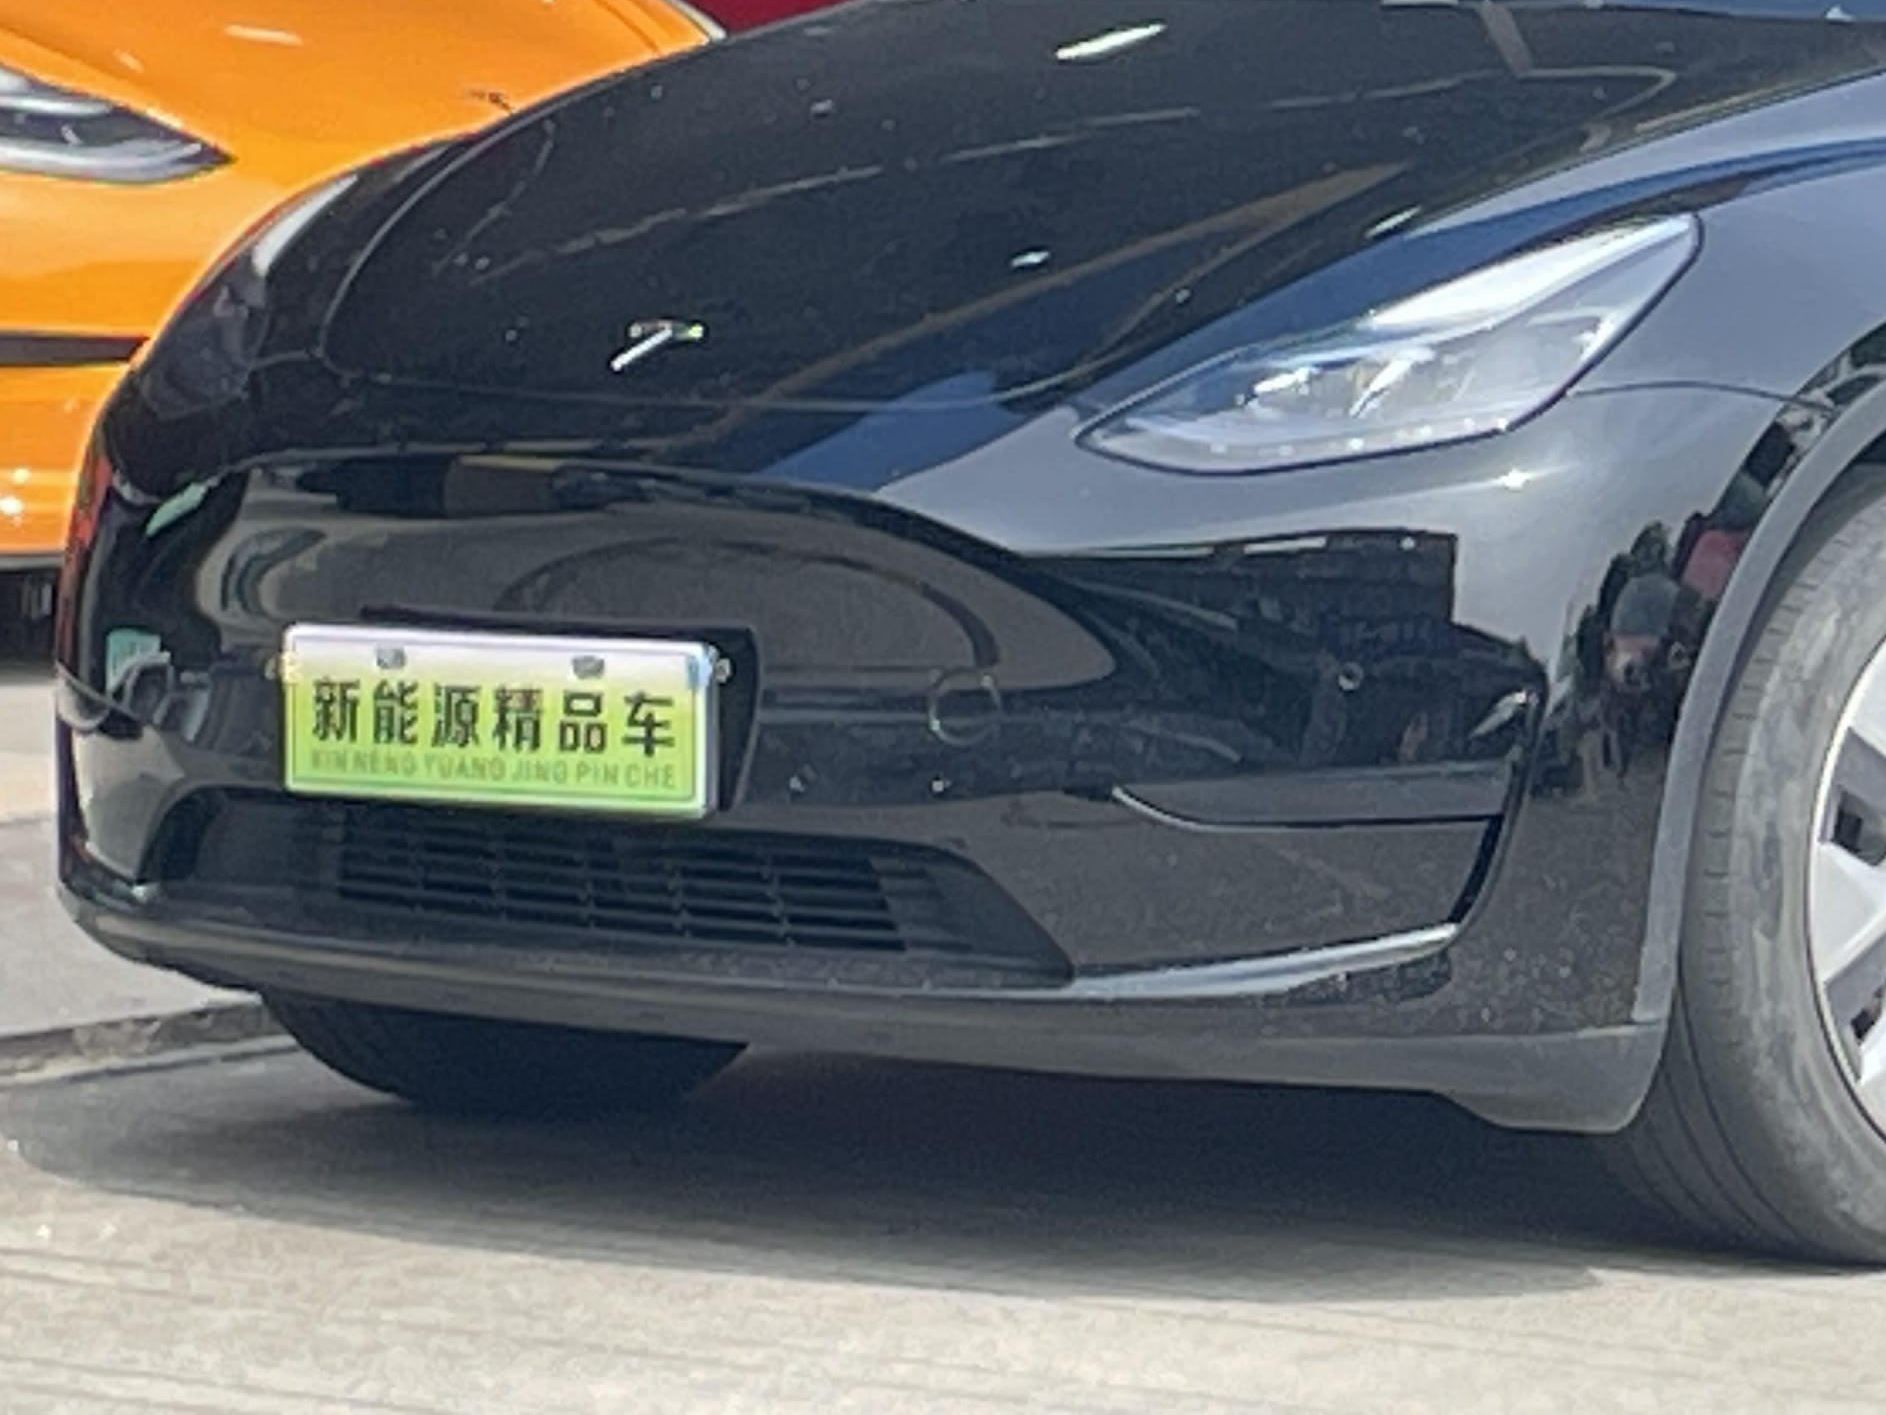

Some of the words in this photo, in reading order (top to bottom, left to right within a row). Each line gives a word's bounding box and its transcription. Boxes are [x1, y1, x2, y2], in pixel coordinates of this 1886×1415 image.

[312, 678, 676, 758] 新能源精品车
